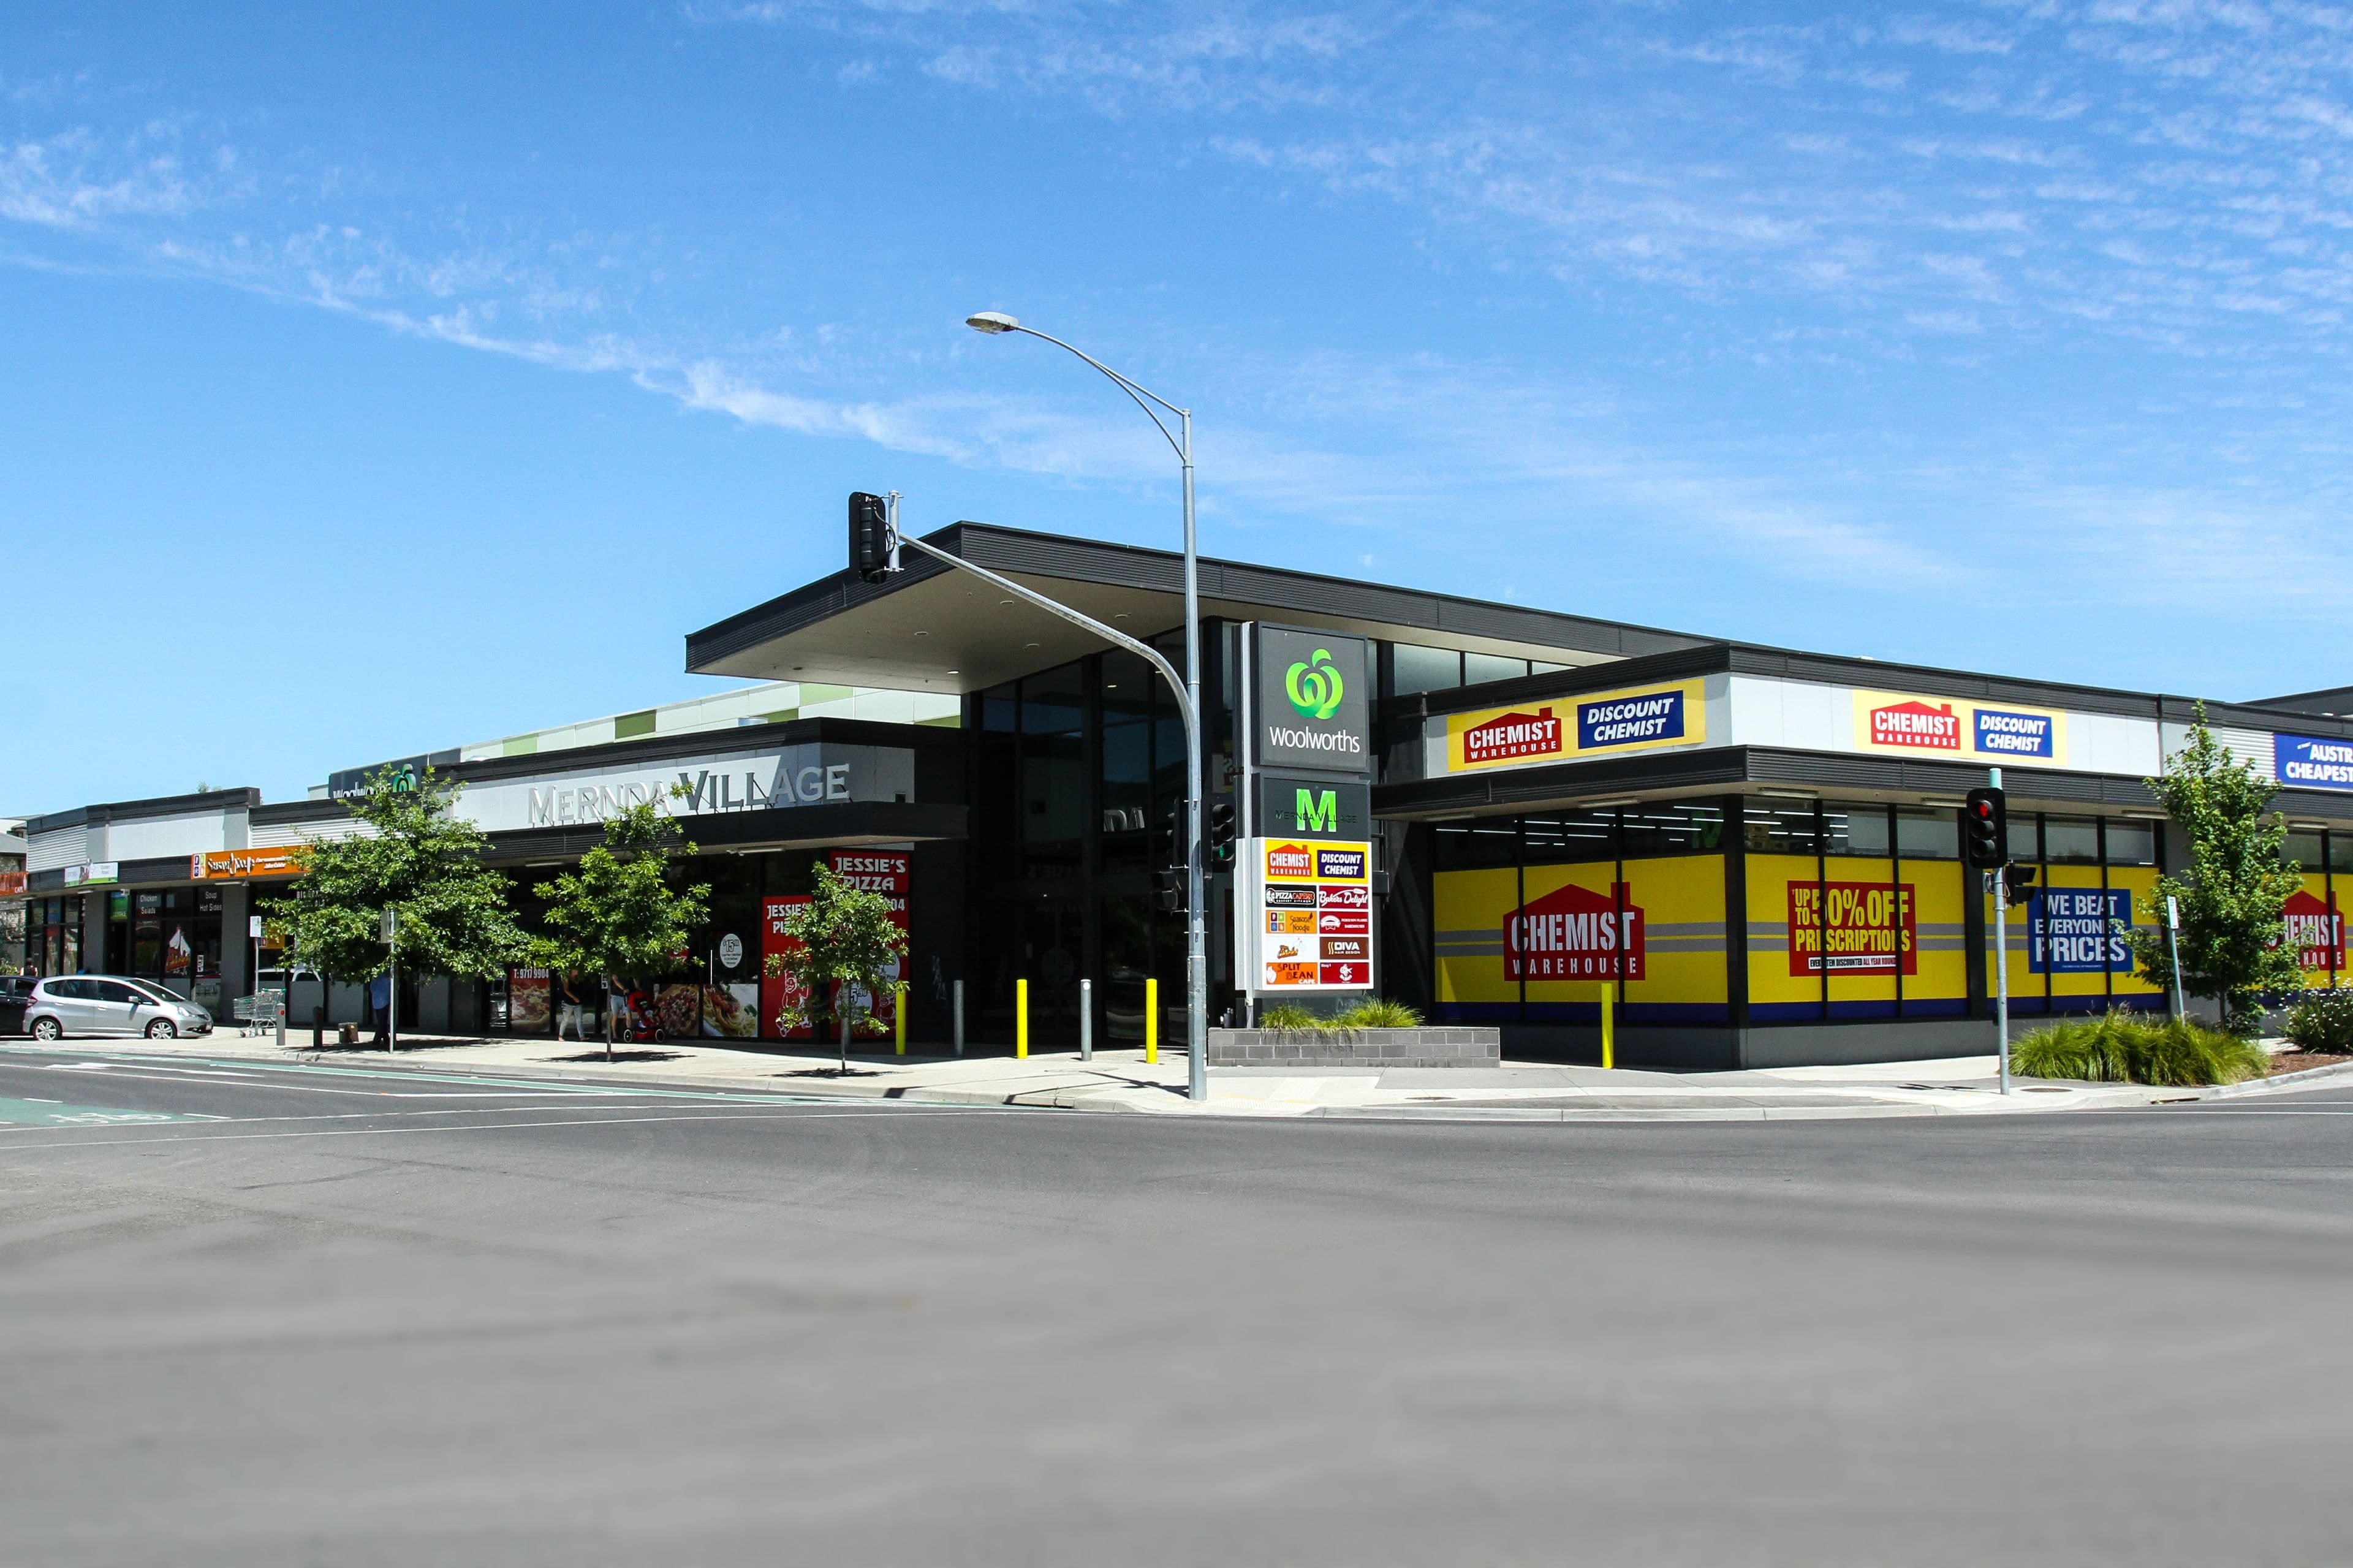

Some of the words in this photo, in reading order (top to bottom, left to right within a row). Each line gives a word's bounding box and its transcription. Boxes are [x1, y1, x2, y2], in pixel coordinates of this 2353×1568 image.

[1587, 698, 1675, 724] DISCOUNT
[1594, 718, 1667, 741] CHEMIST
[1875, 711, 1955, 736] CHEMIST
[1980, 715, 2046, 735] DISCOUNT
[1269, 726, 1360, 753] Woolworths
[1469, 720, 1556, 749] CHEMIST
[1876, 732, 1957, 747] WAREHOUSE
[1985, 733, 2041, 752] CHEMIST
[1471, 740, 1556, 759] WAREHOUSE
[2286, 762, 2353, 782] CHEAPEST
[528, 779, 672, 824] MERNDA
[678, 763, 851, 811] VILLAGE
[1296, 789, 1336, 832] M
[1316, 812, 1357, 824] VLLAGE
[835, 857, 906, 874] JESSIE'S
[1270, 852, 1309, 867] CHEMIST
[1320, 853, 1362, 864] DISCOUNT
[1324, 865, 1358, 876] CHEMIST
[843, 876, 894, 891] PIZZA
[1319, 890, 1342, 907] Bakers
[1344, 892, 1368, 907] Delight
[1866, 890, 1909, 926] OFF
[767, 903, 806, 920] JESSIE'
[1795, 907, 1810, 925] TO
[1511, 912, 1635, 952] CHEMIST
[2268, 915, 2340, 947] EMIST
[1335, 942, 1360, 950] DIVA
[2035, 936, 2126, 962] PRICES
[1278, 963, 1300, 972] SPLIT
[1513, 957, 1636, 974] WAREHOUSE
[1287, 971, 1313, 980] BEAN
